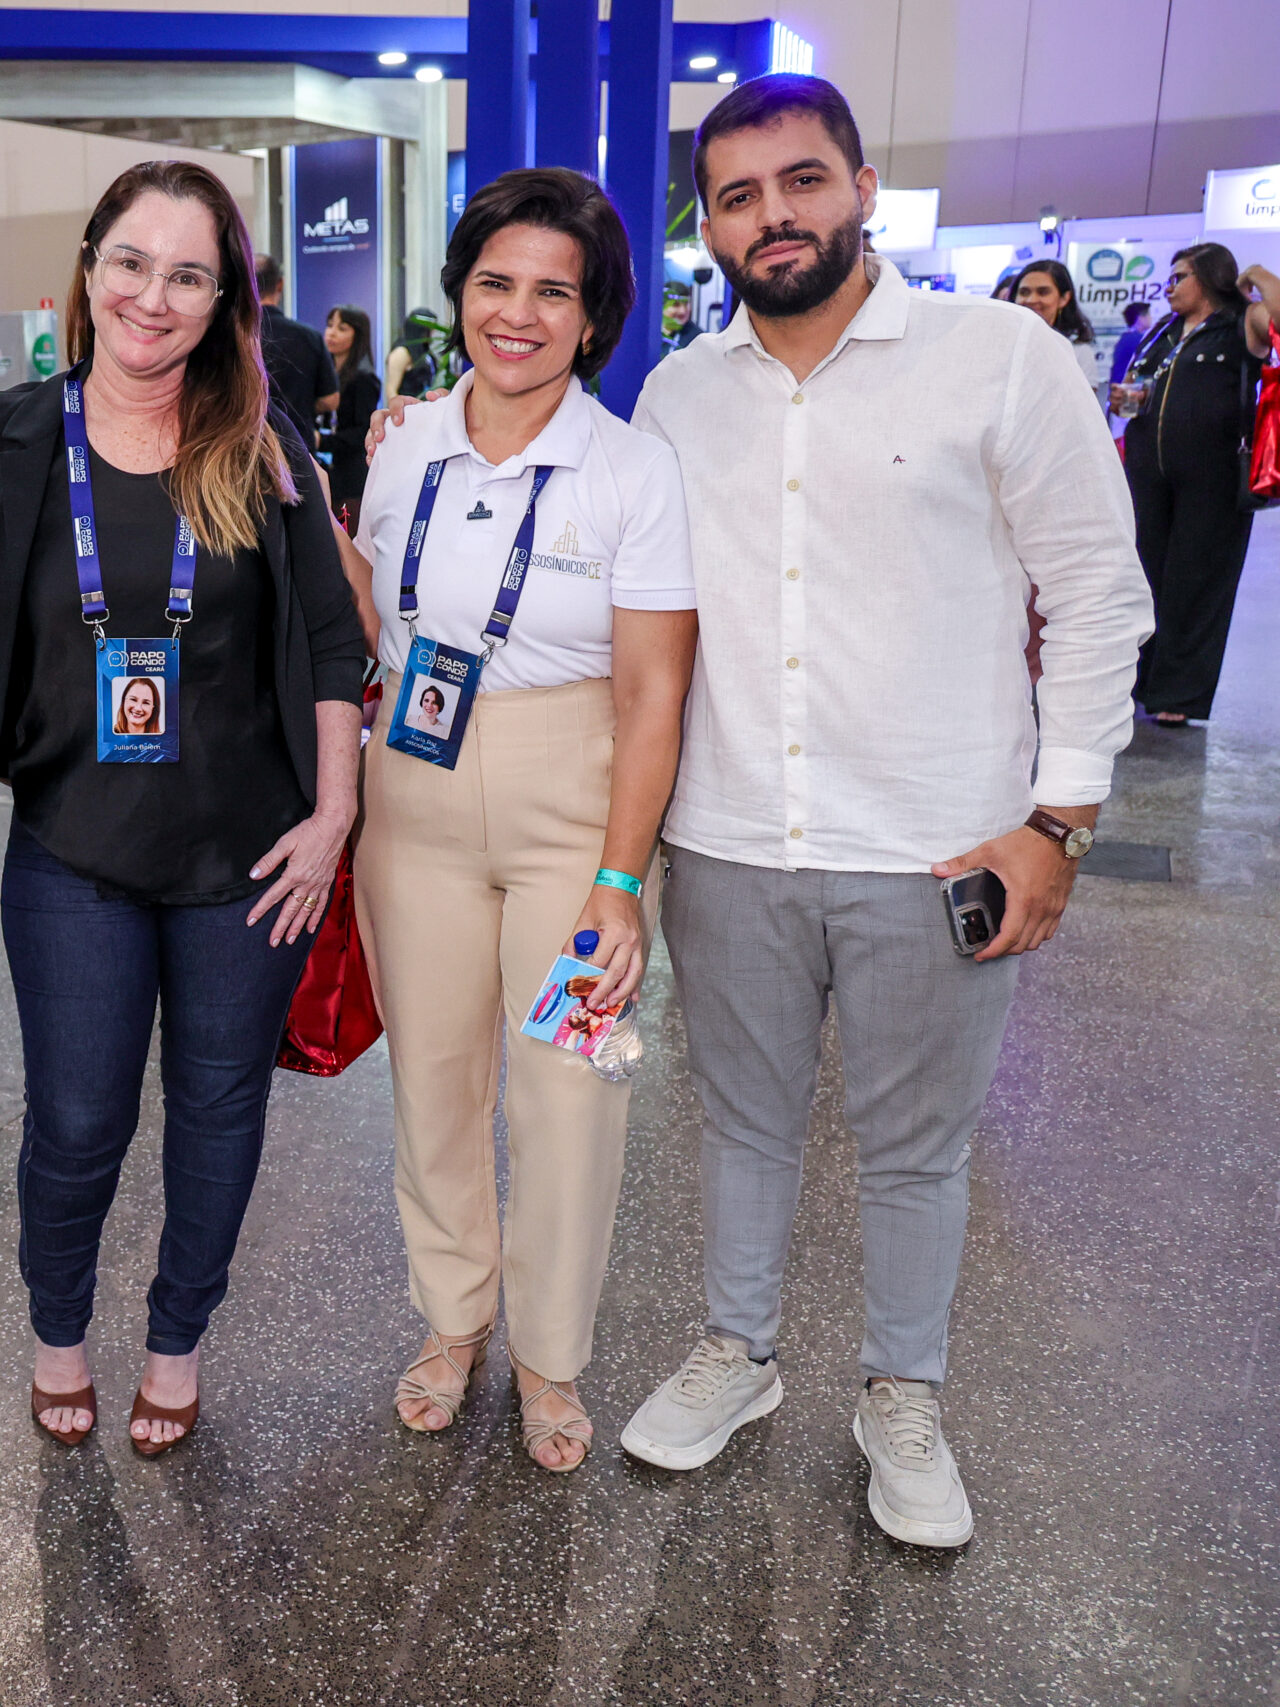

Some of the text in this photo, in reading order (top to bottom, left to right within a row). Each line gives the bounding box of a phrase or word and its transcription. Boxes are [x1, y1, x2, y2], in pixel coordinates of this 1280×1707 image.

[304, 218, 370, 238] METAS
[1079, 283, 1170, 307] limpH2
[73, 390, 81, 414] PAPO
[178, 515, 187, 541] PAPO
[409, 520, 419, 545] PAPO
[80, 529, 90, 557] CONDO
[86, 528, 95, 556] PAPO
[512, 564, 525, 591] PAPO
[130, 651, 166, 660] PAPO
[437, 655, 469, 672] PAPO
[436, 662, 467, 678] CONDO
